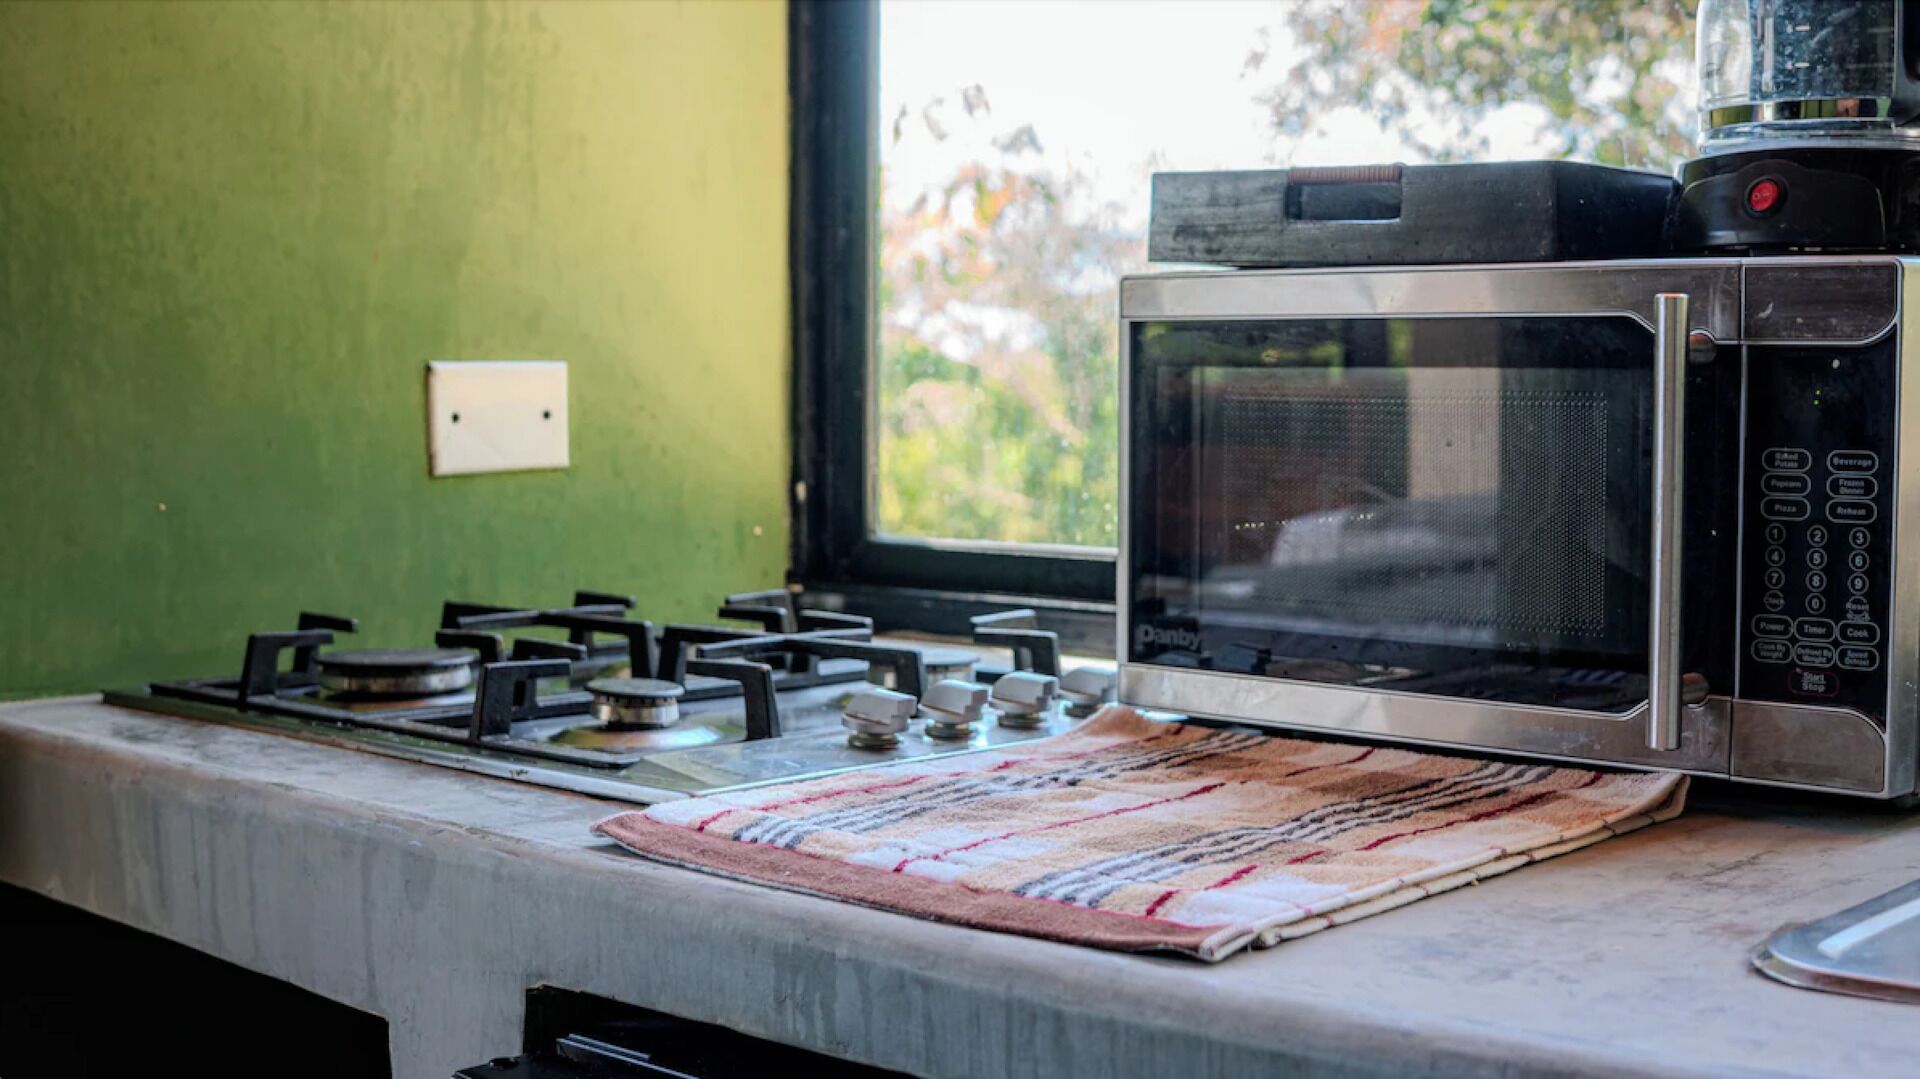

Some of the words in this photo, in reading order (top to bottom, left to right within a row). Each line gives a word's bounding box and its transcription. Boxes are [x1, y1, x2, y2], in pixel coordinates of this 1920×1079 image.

[1833, 457, 1872, 468] Beverage
[1771, 479, 1802, 489] Popcorn
[1774, 504, 1798, 513] Pizza
[1836, 506, 1867, 516] Reheat
[1771, 528, 1778, 539] 1
[1813, 529, 1822, 542] 2
[1856, 532, 1865, 545] 3
[1771, 550, 1780, 562] 4
[1813, 552, 1821, 565] 5
[1855, 555, 1863, 567] 6
[1771, 573, 1779, 585] 7
[1812, 575, 1821, 587] 8
[1854, 578, 1863, 590] 9
[1812, 597, 1820, 609] 0
[1760, 621, 1785, 632] Power
[1803, 624, 1827, 634] Timer
[1138, 624, 1201, 651] Danby
[1846, 628, 1870, 638] Cook
[1802, 672, 1825, 682] Start
[1802, 682, 1826, 693] Stop
